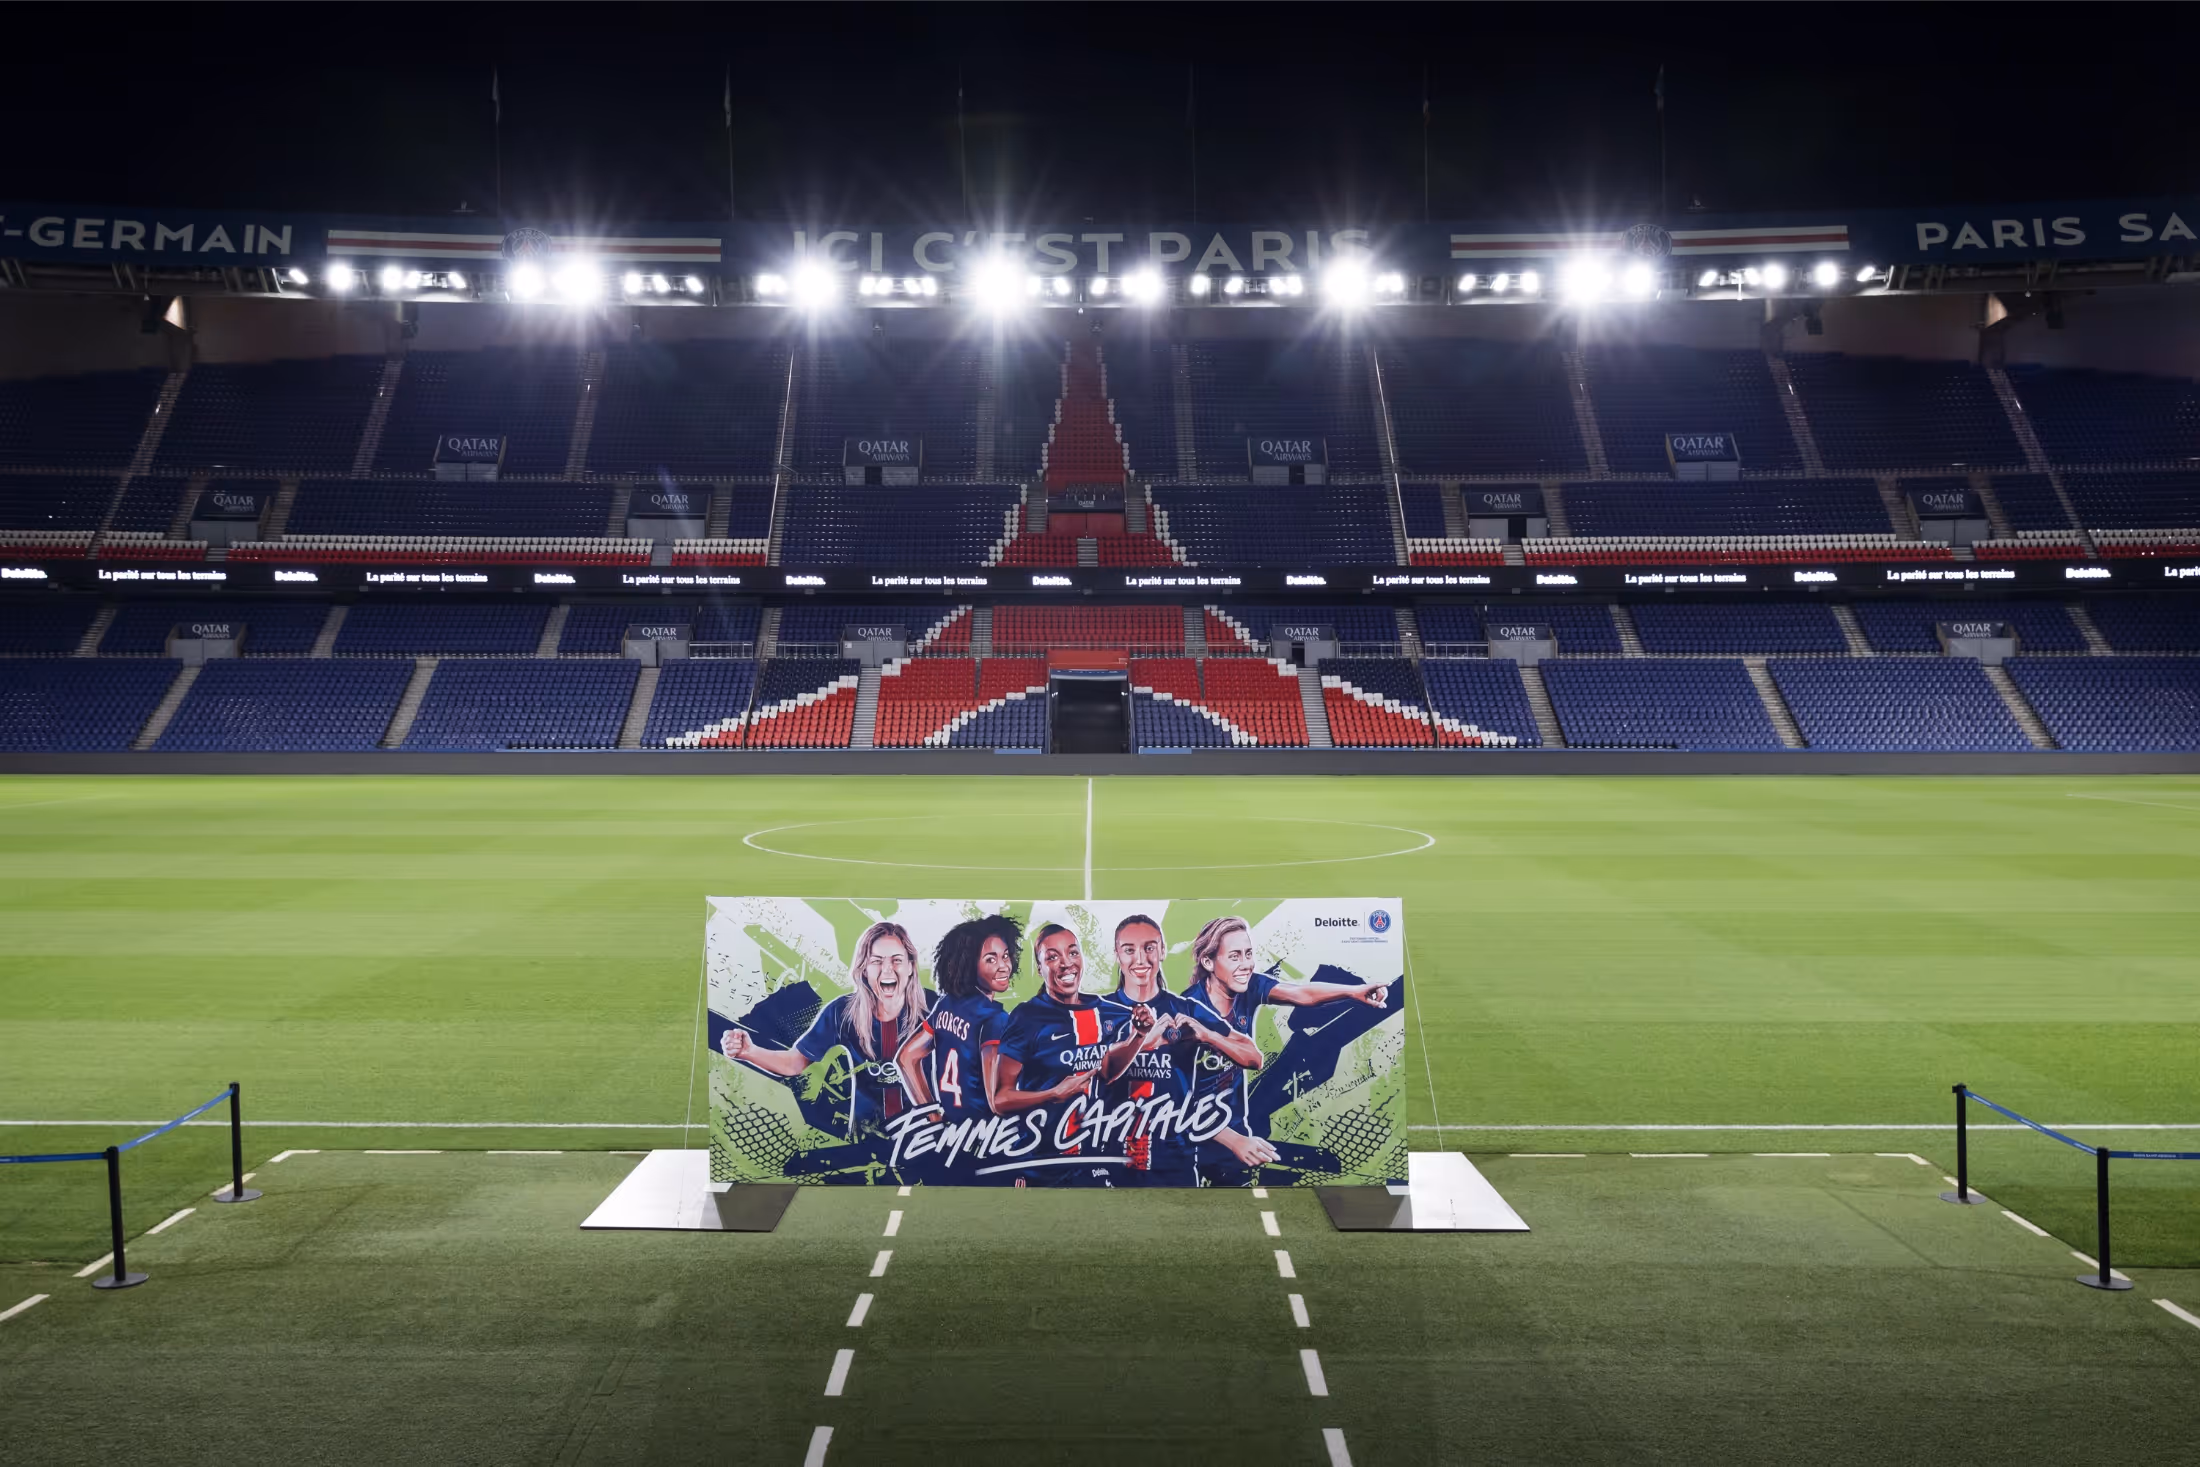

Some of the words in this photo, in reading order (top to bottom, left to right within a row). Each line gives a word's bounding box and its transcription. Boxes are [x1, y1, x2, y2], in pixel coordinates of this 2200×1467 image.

[0, 215, 293, 255] -GERMAIN
[1916, 217, 2086, 251] PARIS
[2118, 211, 2198, 243] SA
[793, 231, 883, 273] ICI
[448, 438, 499, 452] QATAR
[858, 440, 909, 454] QATAR
[1260, 440, 1312, 454] QATAR
[1673, 437, 1724, 451] QATAR
[1273, 452, 1312, 461] AIRWAYS
[213, 495, 254, 507] QATAR
[651, 494, 689, 506] QATAR
[1483, 493, 1522, 505] QATAR
[1922, 493, 1964, 505] QATAR
[2165, 567, 2178, 576] La
[623, 575, 634, 583] La
[636, 575, 660, 585] parité
[676, 576, 694, 584] tous
[696, 575, 708, 584] les
[709, 575, 740, 584] terrains
[872, 576, 883, 584] La
[885, 576, 908, 586] parité
[924, 577, 942, 585] tous
[943, 576, 955, 585] les
[957, 577, 988, 585] terrains
[1126, 576, 1137, 585] La
[1138, 576, 1162, 587] parité
[1163, 577, 1177, 585] sur
[1178, 576, 1195, 585] tous
[1196, 575, 1209, 585] les
[1210, 576, 1241, 585] terrains
[1373, 575, 1385, 584] La
[1386, 575, 1410, 586] parité
[1411, 576, 1425, 584] sur
[1426, 576, 1444, 584] tous
[1445, 575, 1457, 584] les
[1459, 575, 1490, 584] terrains
[1625, 574, 1637, 583] La
[1638, 574, 1663, 585] parité
[1680, 575, 1698, 583] tous
[1700, 573, 1712, 582] les
[1714, 573, 1747, 582] terrains
[192, 624, 230, 634] QATAR
[642, 627, 677, 637] QATAR
[857, 627, 892, 638] QATAR
[1284, 627, 1319, 637] QATAR
[1500, 627, 1536, 637] QATAR
[1953, 623, 1991, 634] QATAR
[1073, 1058, 1102, 1071] AIRWA
[1132, 1053, 1172, 1069] ATAR
[939, 1047, 962, 1107] 4
[1126, 1066, 1172, 1079] AIRWAYS
[884, 1103, 1047, 1168] FEMMES
